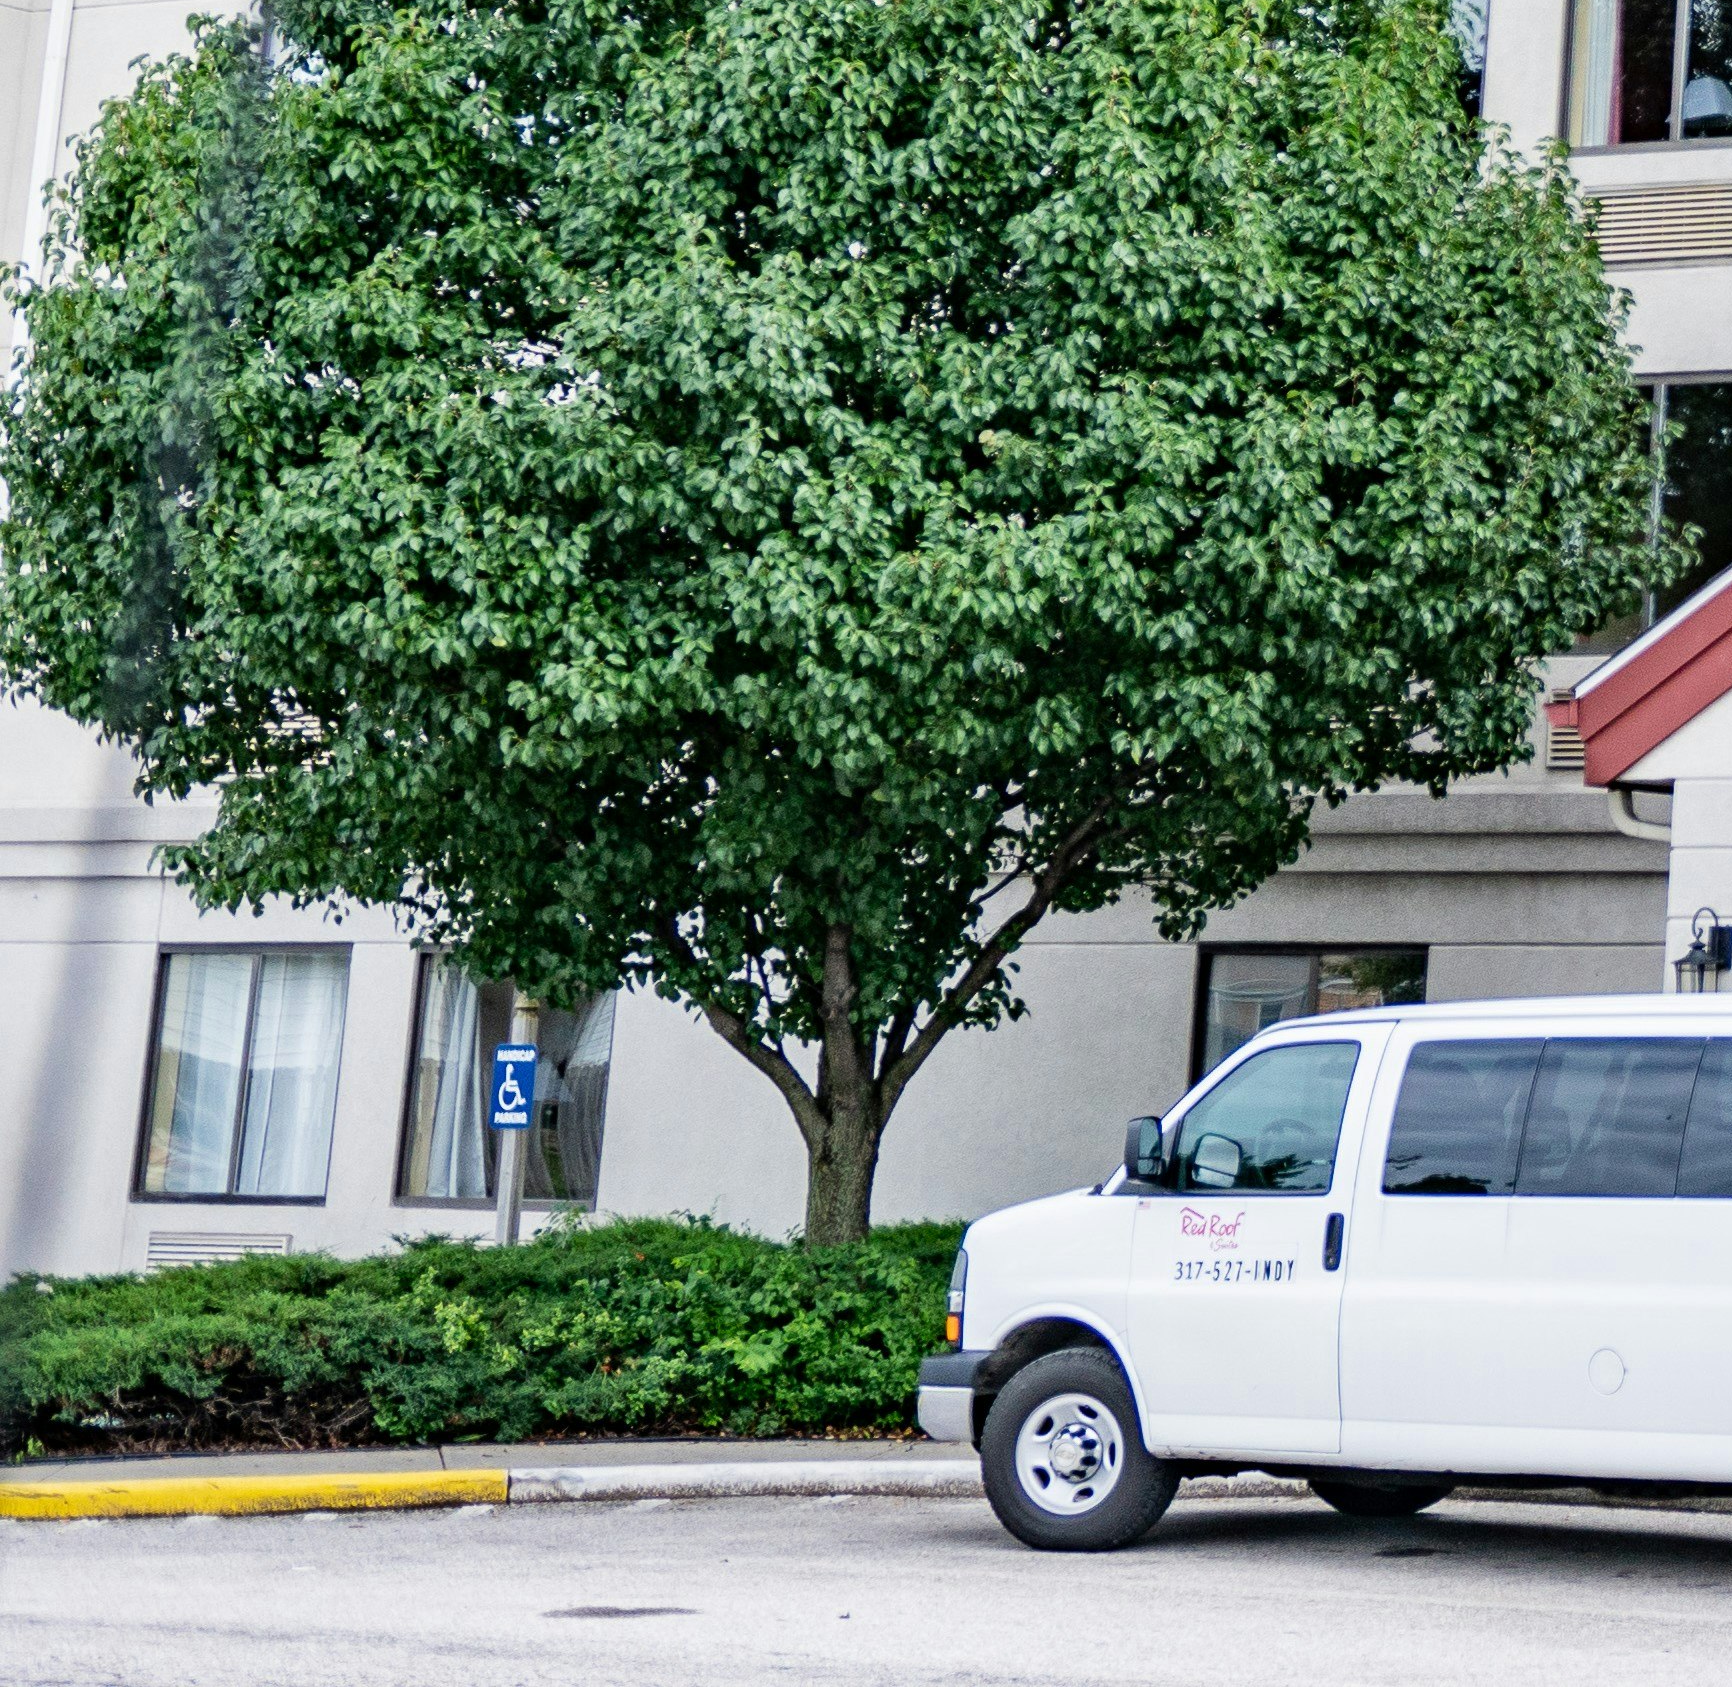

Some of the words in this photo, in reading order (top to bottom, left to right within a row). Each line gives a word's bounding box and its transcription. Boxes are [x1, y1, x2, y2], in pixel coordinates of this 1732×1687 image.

[1182, 1215, 1207, 1236] Red
[1209, 1212, 1245, 1237] Roof
[1174, 1259, 1294, 1281] 317-527-INDY
